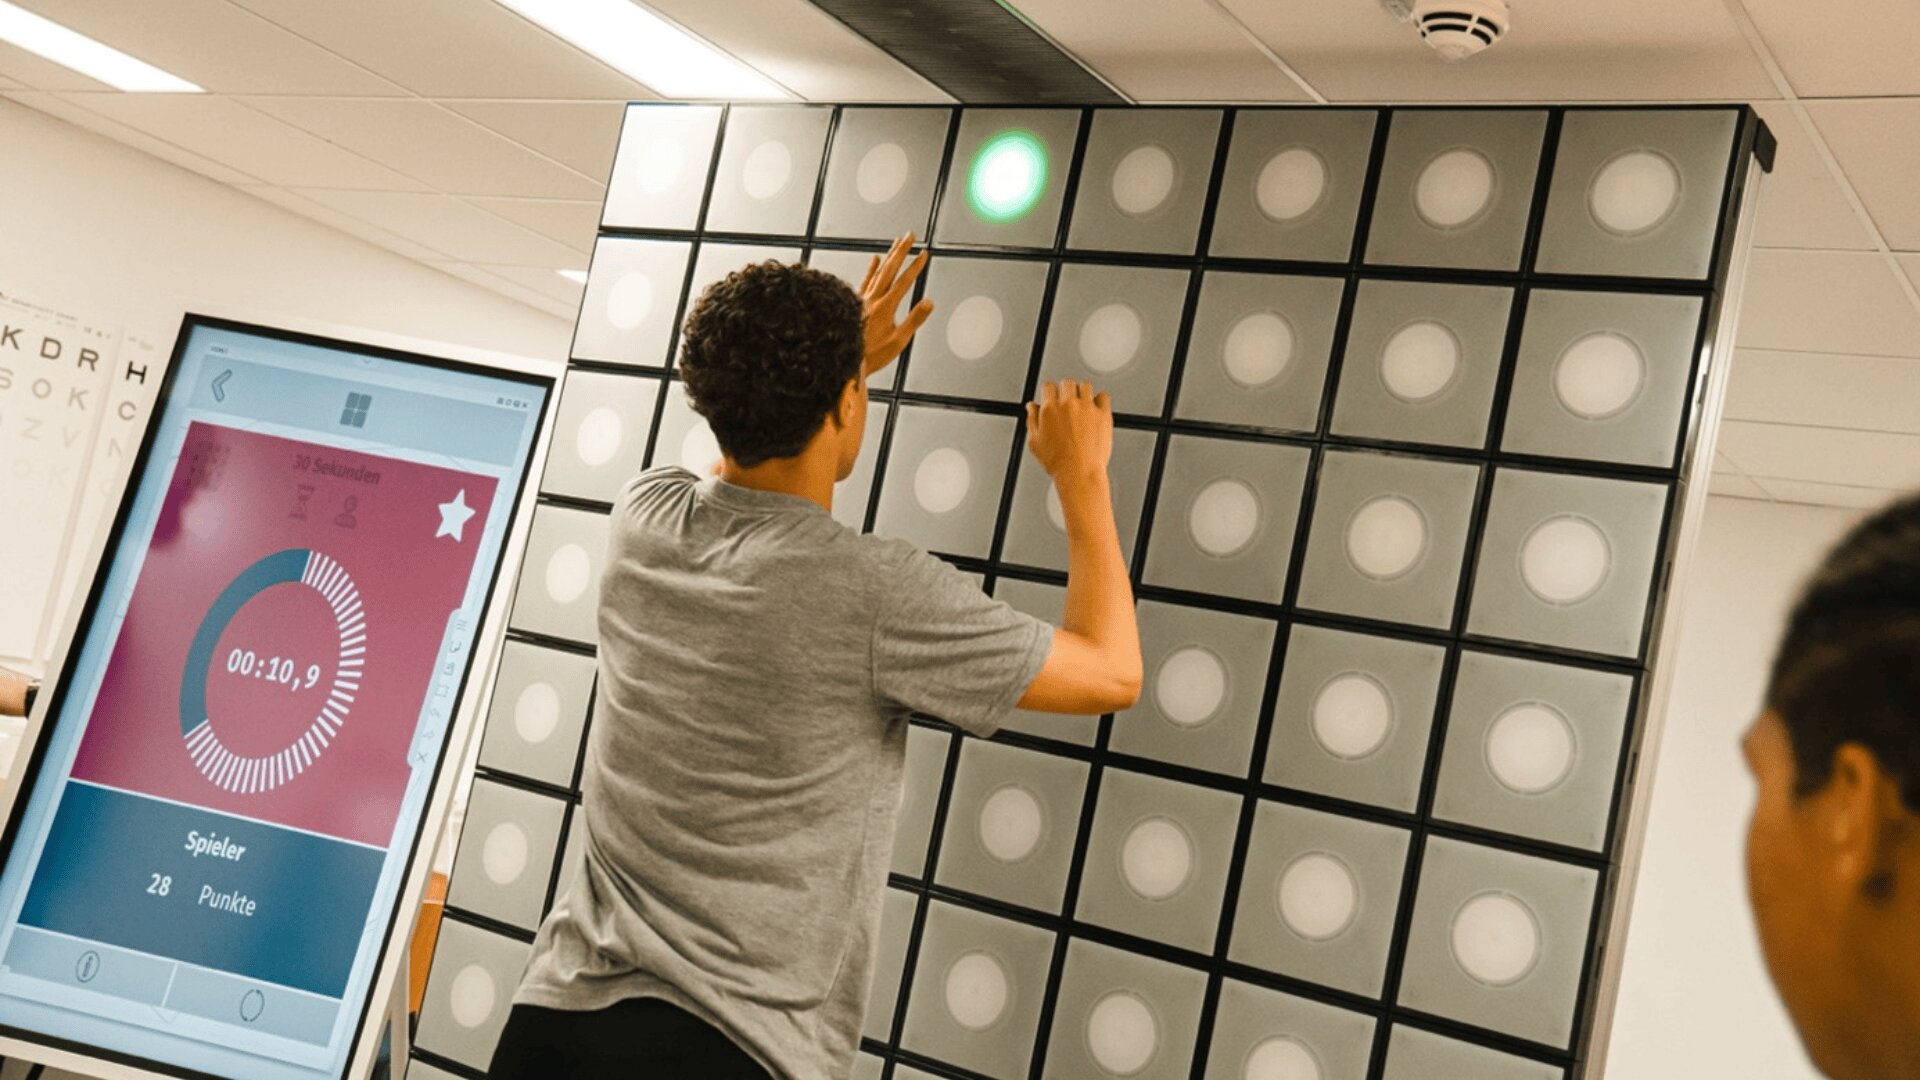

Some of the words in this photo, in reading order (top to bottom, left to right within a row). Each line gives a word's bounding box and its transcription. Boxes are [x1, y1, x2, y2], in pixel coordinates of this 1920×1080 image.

[1, 325, 23, 351] K
[40, 336, 62, 360] D
[77, 347, 100, 372] R
[125, 360, 148, 385] H
[292, 454, 311, 472] 30
[312, 457, 382, 485] Sekunden
[226, 647, 321, 693] 00:10,9
[184, 830, 247, 861] Spieler
[146, 872, 173, 897] 28
[198, 884, 257, 917] Punkte
